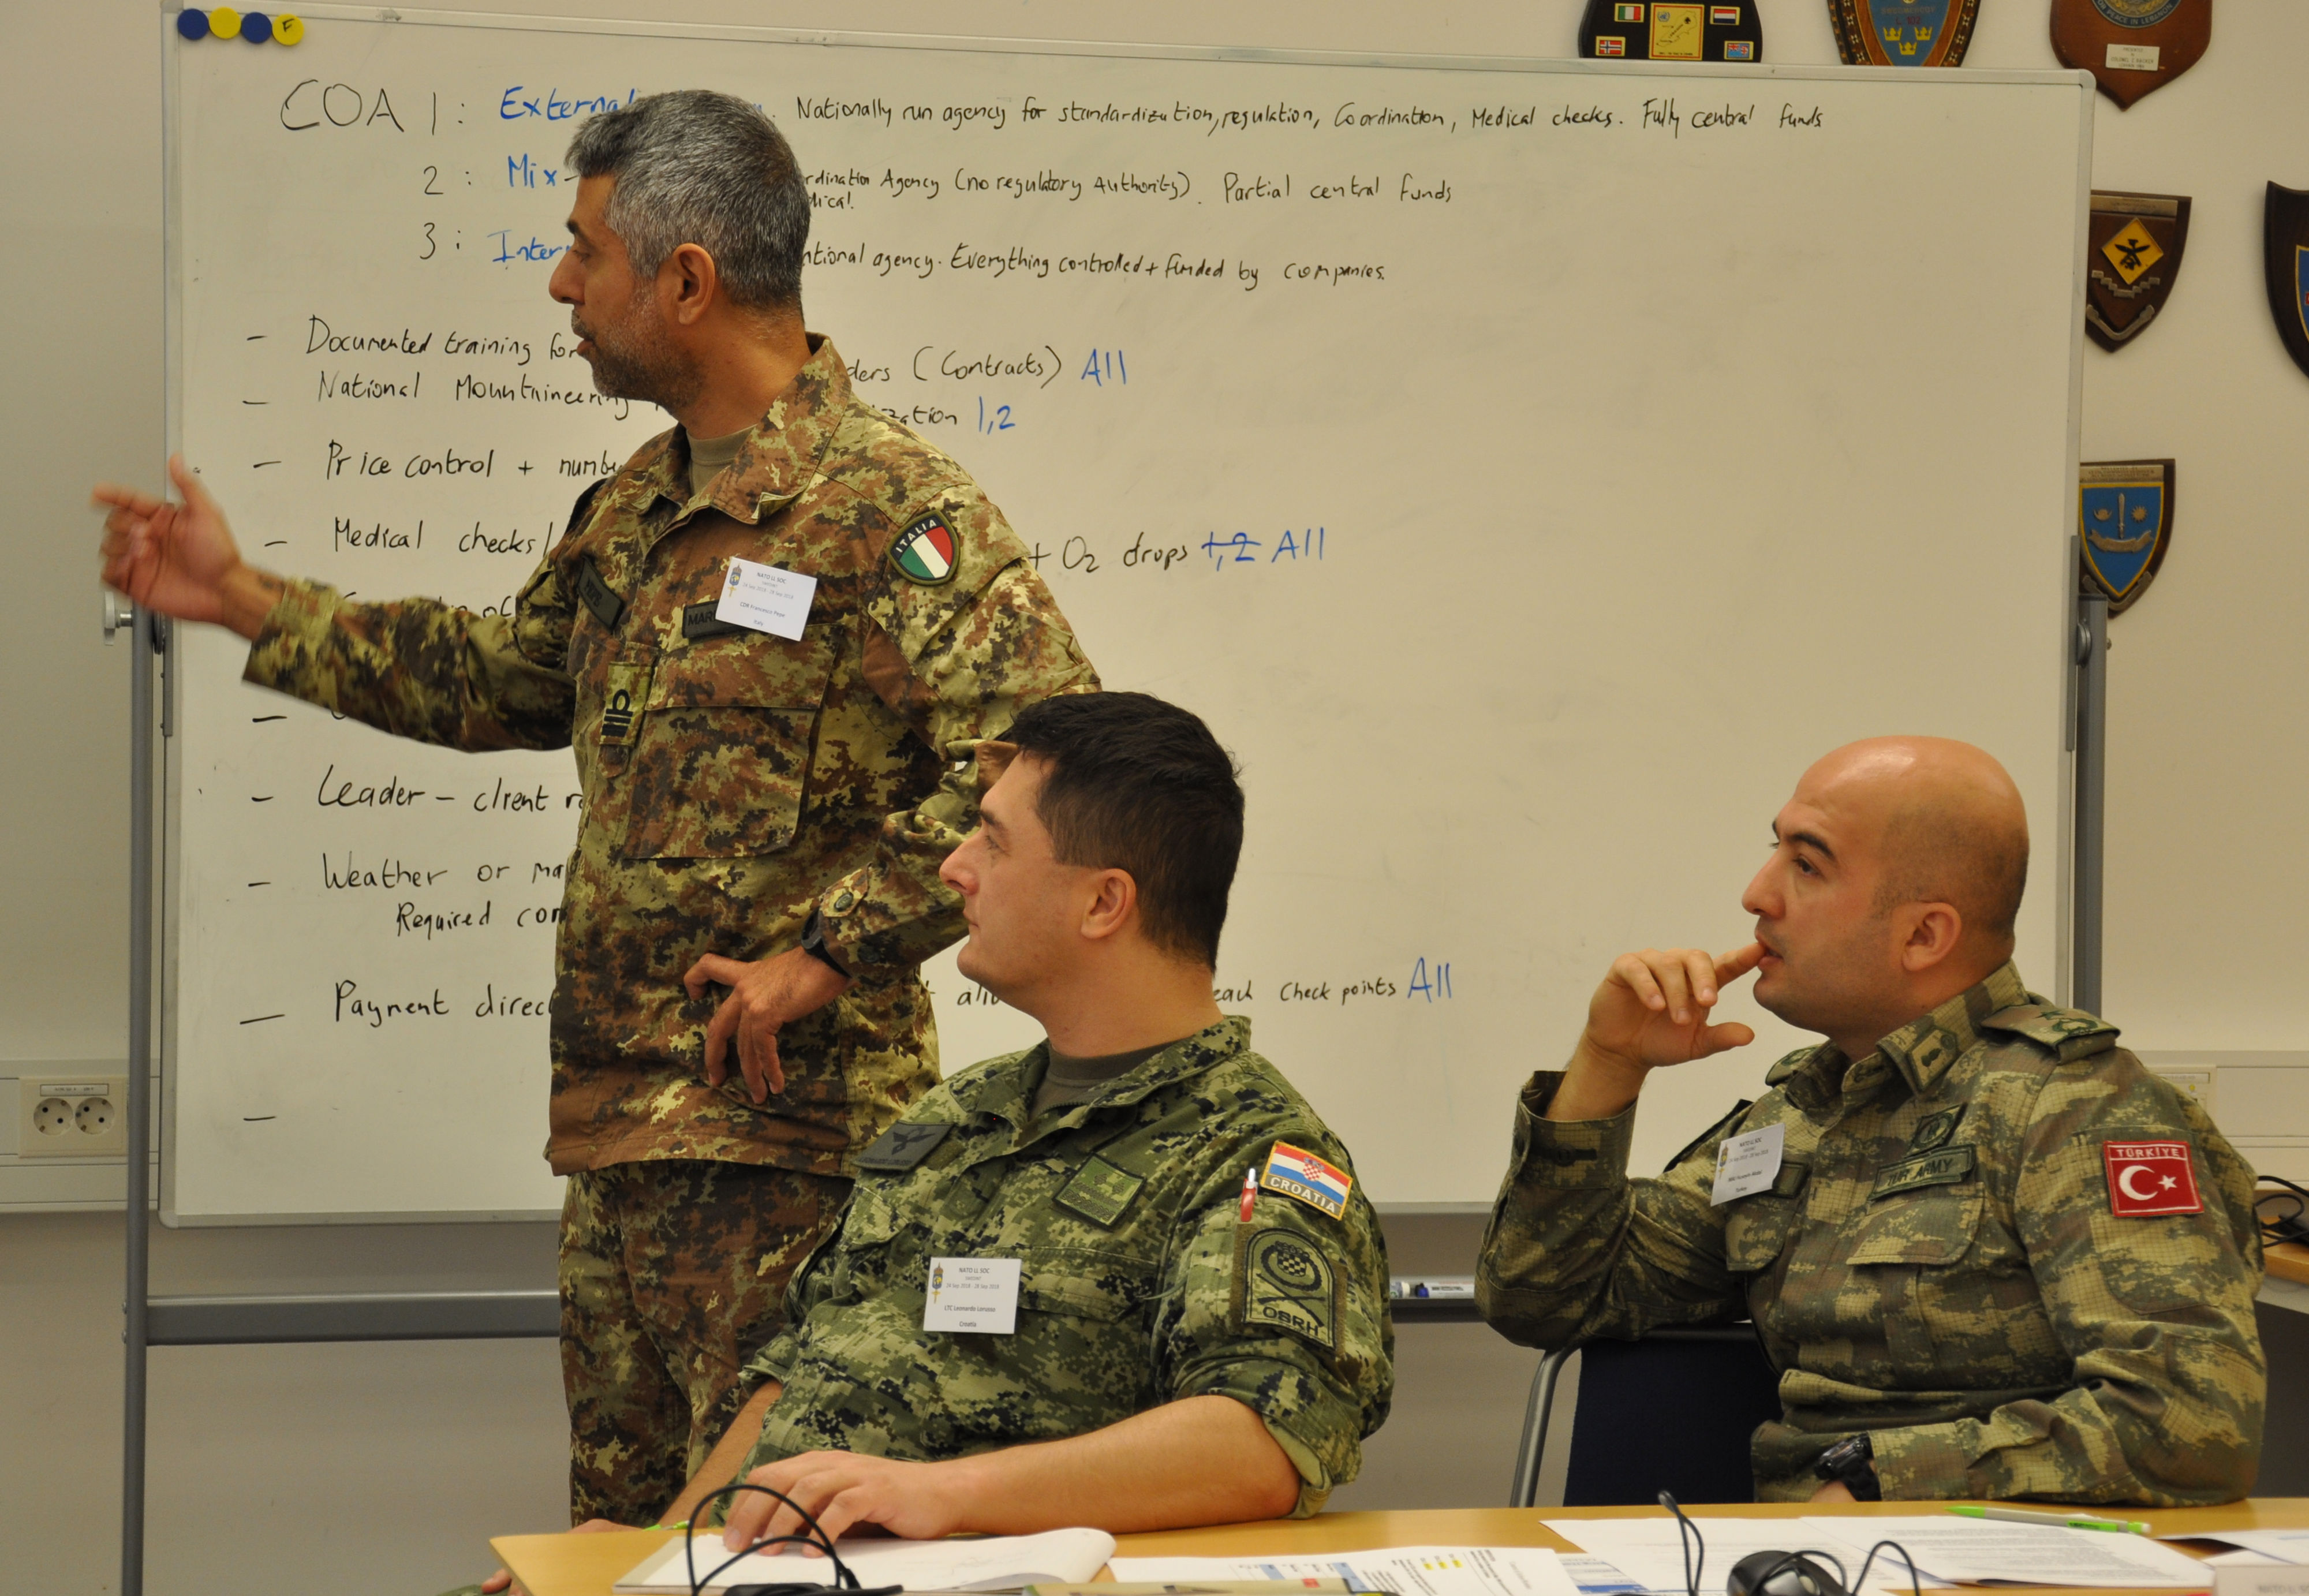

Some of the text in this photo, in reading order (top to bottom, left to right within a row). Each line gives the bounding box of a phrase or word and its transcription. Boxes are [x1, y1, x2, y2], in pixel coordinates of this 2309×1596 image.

[2141, 3, 2173, 24] LEBANON
[280, 79, 405, 133] COA
[797, 96, 892, 128] Nationally
[902, 106, 933, 121] run
[943, 106, 1006, 131] agency
[1022, 96, 1047, 122] for
[1472, 106, 1536, 129] Medical
[1642, 98, 1680, 139] Fully
[1691, 103, 1755, 129] central
[1779, 103, 1823, 129] funds
[805, 168, 870, 186] rdination
[880, 168, 939, 200] Agency
[1224, 171, 1290, 204] Partial
[1310, 175, 1379, 199] central
[1400, 173, 1451, 203] funds
[487, 229, 570, 263] Inter
[950, 242, 1049, 278] Everything
[1164, 253, 1225, 279] funded
[1238, 260, 1258, 291] by
[305, 314, 433, 354] Documented
[444, 331, 531, 367] training
[847, 359, 890, 382] ders
[1081, 348, 1127, 387] All
[318, 370, 420, 402] National
[326, 439, 392, 480] Price
[404, 448, 495, 479] control
[559, 450, 622, 477] numbe
[335, 516, 423, 552] Medical
[1123, 531, 1188, 571] drops
[1271, 526, 1324, 563] All
[896, 519, 936, 552] ITALIA
[757, 572, 771, 580] NATO
[688, 609, 716, 626] MARI
[750, 604, 773, 615] Francesco
[317, 764, 425, 808] Leader
[473, 777, 549, 813] client
[322, 853, 448, 889] Weather
[477, 864, 510, 883] or
[396, 900, 491, 941] Required
[335, 979, 450, 1028] Payment
[475, 984, 552, 1018] direc
[1342, 977, 1396, 1006] points
[1407, 956, 1452, 1003] All
[1270, 1177, 1335, 1213] CROATIA
